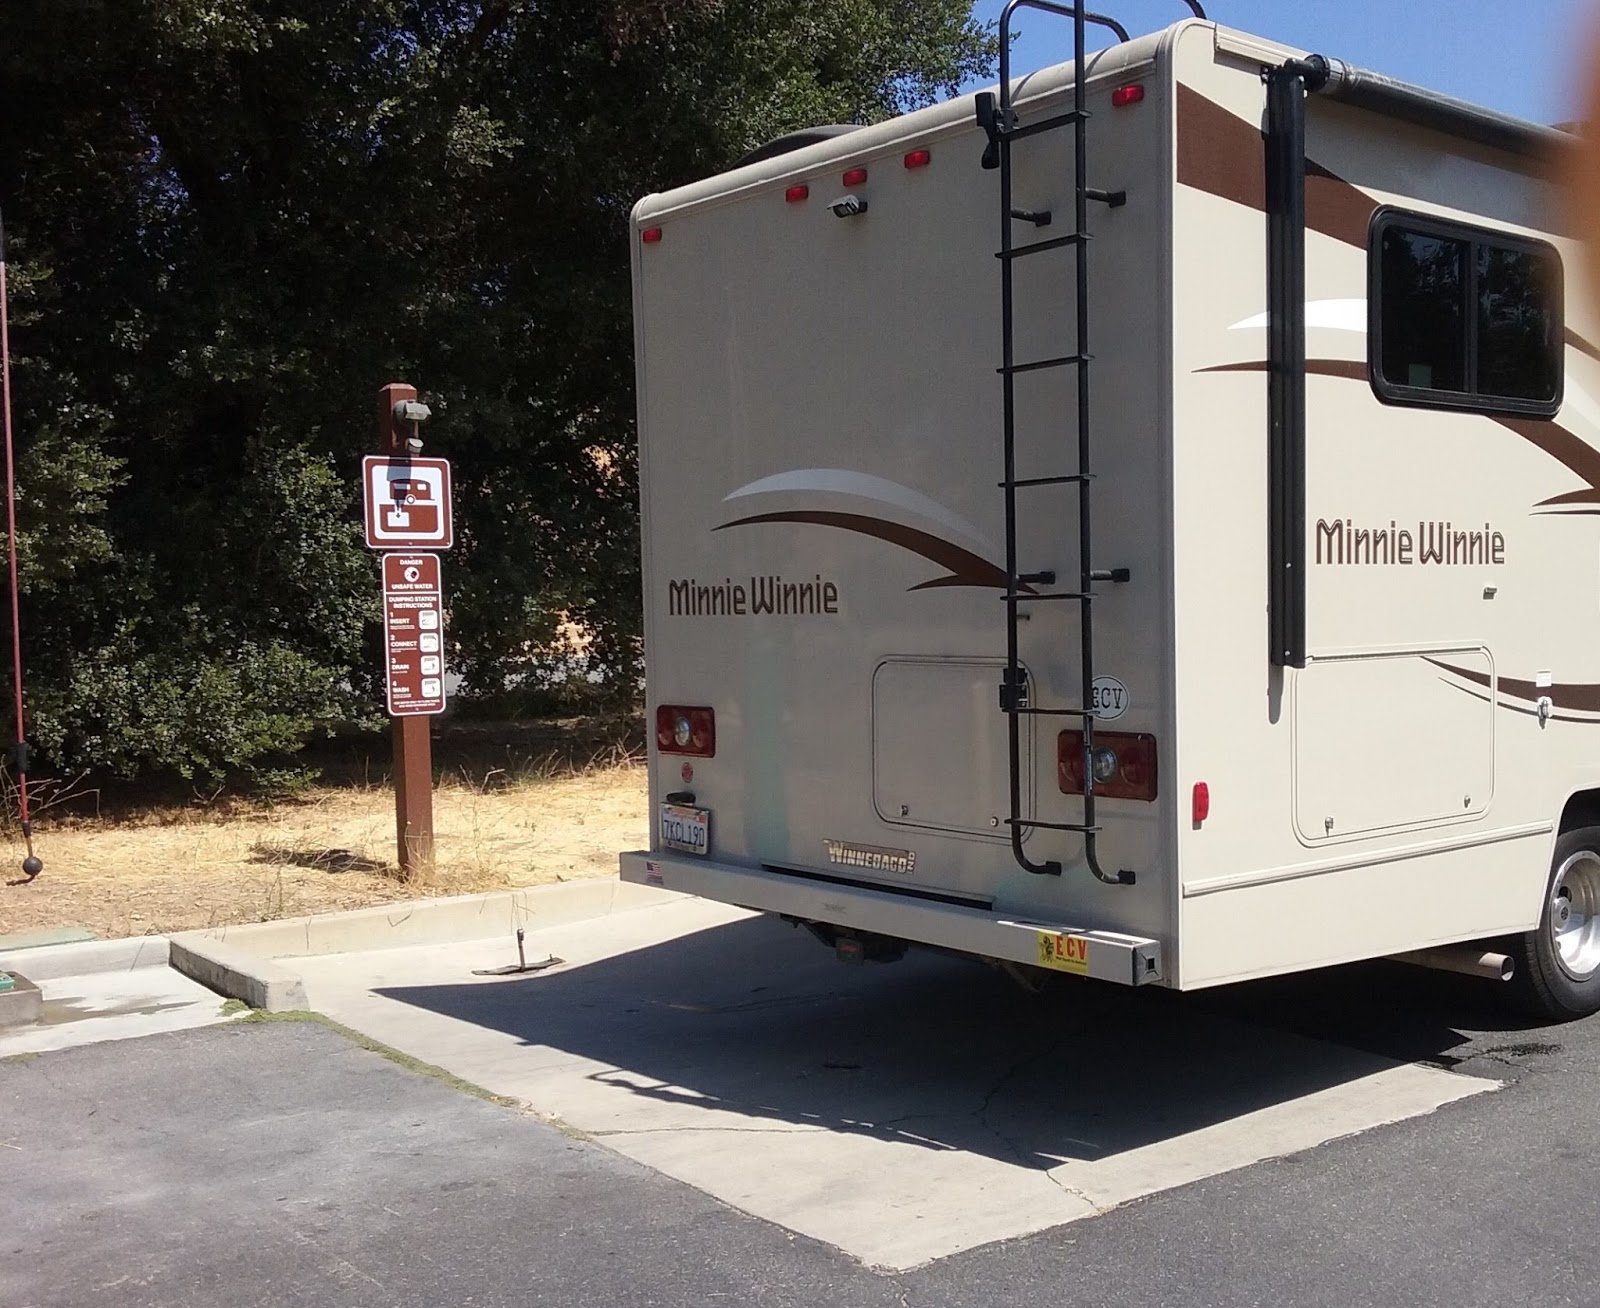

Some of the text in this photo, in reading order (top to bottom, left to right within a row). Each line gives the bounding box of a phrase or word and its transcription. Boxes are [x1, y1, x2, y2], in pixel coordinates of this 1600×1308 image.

[1316, 518, 1505, 565] Minnie Winnie
[669, 574, 838, 616] Minnie Winnie
[1091, 686, 1123, 710] ECV
[663, 819, 705, 847] 7KCL190
[1056, 935, 1087, 961] ECV
